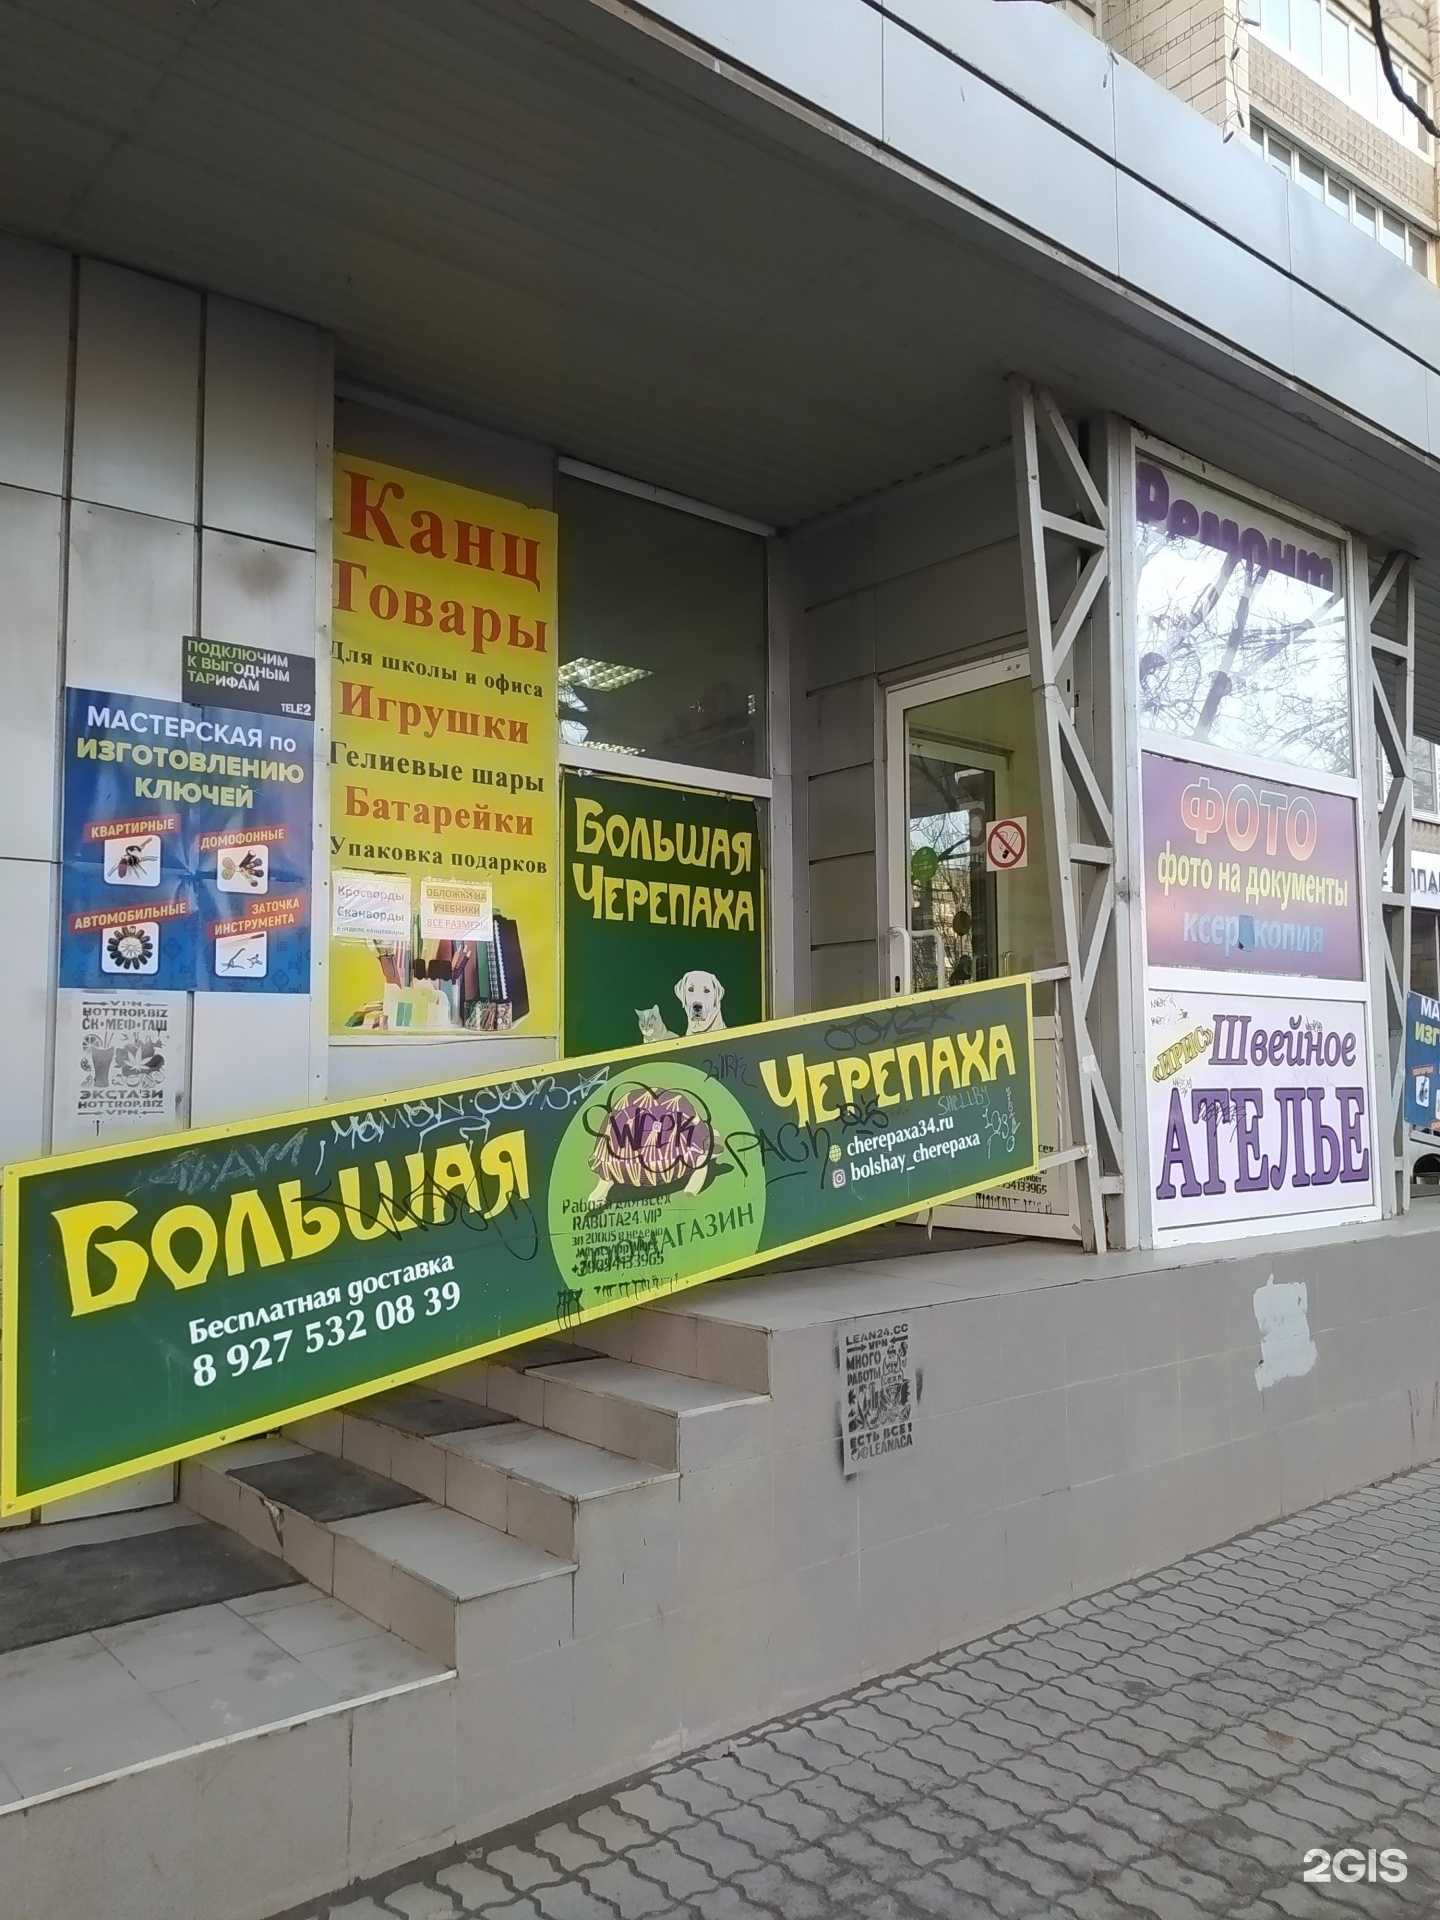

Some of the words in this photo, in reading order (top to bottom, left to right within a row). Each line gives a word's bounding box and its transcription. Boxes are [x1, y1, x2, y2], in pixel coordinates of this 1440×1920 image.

[342, 470, 541, 592] Канц
[332, 558, 548, 655] Товары
[187, 640, 288, 667] ПОДКЛЮЧИМ
[187, 655, 197, 668] К
[201, 657, 290, 682] ВЫГОДНЫМ
[332, 640, 372, 666] Для
[382, 656, 457, 682] школы
[465, 671, 476, 686] и
[484, 673, 544, 699] офиса
[187, 670, 260, 692] ТАРИФАМ
[87, 706, 263, 748] МАСТЕРСКАЯ
[270, 736, 296, 752] по
[281, 703, 311, 716] TELE2
[338, 680, 529, 745] Игрушки
[77, 737, 304, 784] ИЗГОТОВЛЕНИЮ
[331, 741, 463, 781] Гелиевые
[472, 768, 545, 796] шары
[135, 776, 255, 809] КЛЮЧЕЙ
[344, 785, 534, 837] Батарейки
[91, 819, 175, 838] КВАРТИРНЫЕ
[200, 828, 285, 850] ДОМОФОННЫЕ
[574, 797, 752, 876] БОЛЬШАЯ
[1180, 776, 1318, 861] ФОТО
[331, 836, 443, 866] Упаковка
[451, 853, 548, 875] подарков
[1157, 840, 1213, 897] фото
[1217, 855, 1241, 893] на
[1245, 864, 1348, 911] документы
[75, 903, 187, 929] АВТОМОБИЛЬНЫЕ
[252, 899, 300, 914] ЗАТОЧКА
[433, 903, 480, 915] УЧЕБНИКИ
[572, 862, 755, 931] ЧЕРЕПАХА
[215, 914, 294, 934] ИНСТРУМЕНТА
[1183, 911, 1324, 958] ксеркопия
[1209, 1014, 1357, 1068] Швейное
[759, 1024, 1016, 1128] ЧЕРЕПАХА
[846, 1115, 955, 1156] cherepaxa34.ru
[850, 1132, 981, 1182] bolshay_cherepaxa
[1156, 1087, 1370, 1200] АТЕЛЬЕ
[52, 1130, 531, 1317] БОЛЬШАЯ
[189, 1286, 342, 1345] Бесплатная
[348, 1253, 455, 1305] доставка
[193, 1354, 217, 1387] 8
[226, 1330, 293, 1378] 927
[306, 1308, 367, 1354] 532
[376, 1294, 416, 1332] 08
[425, 1281, 461, 1317] 39
[846, 1350, 881, 1371] МНОГО
